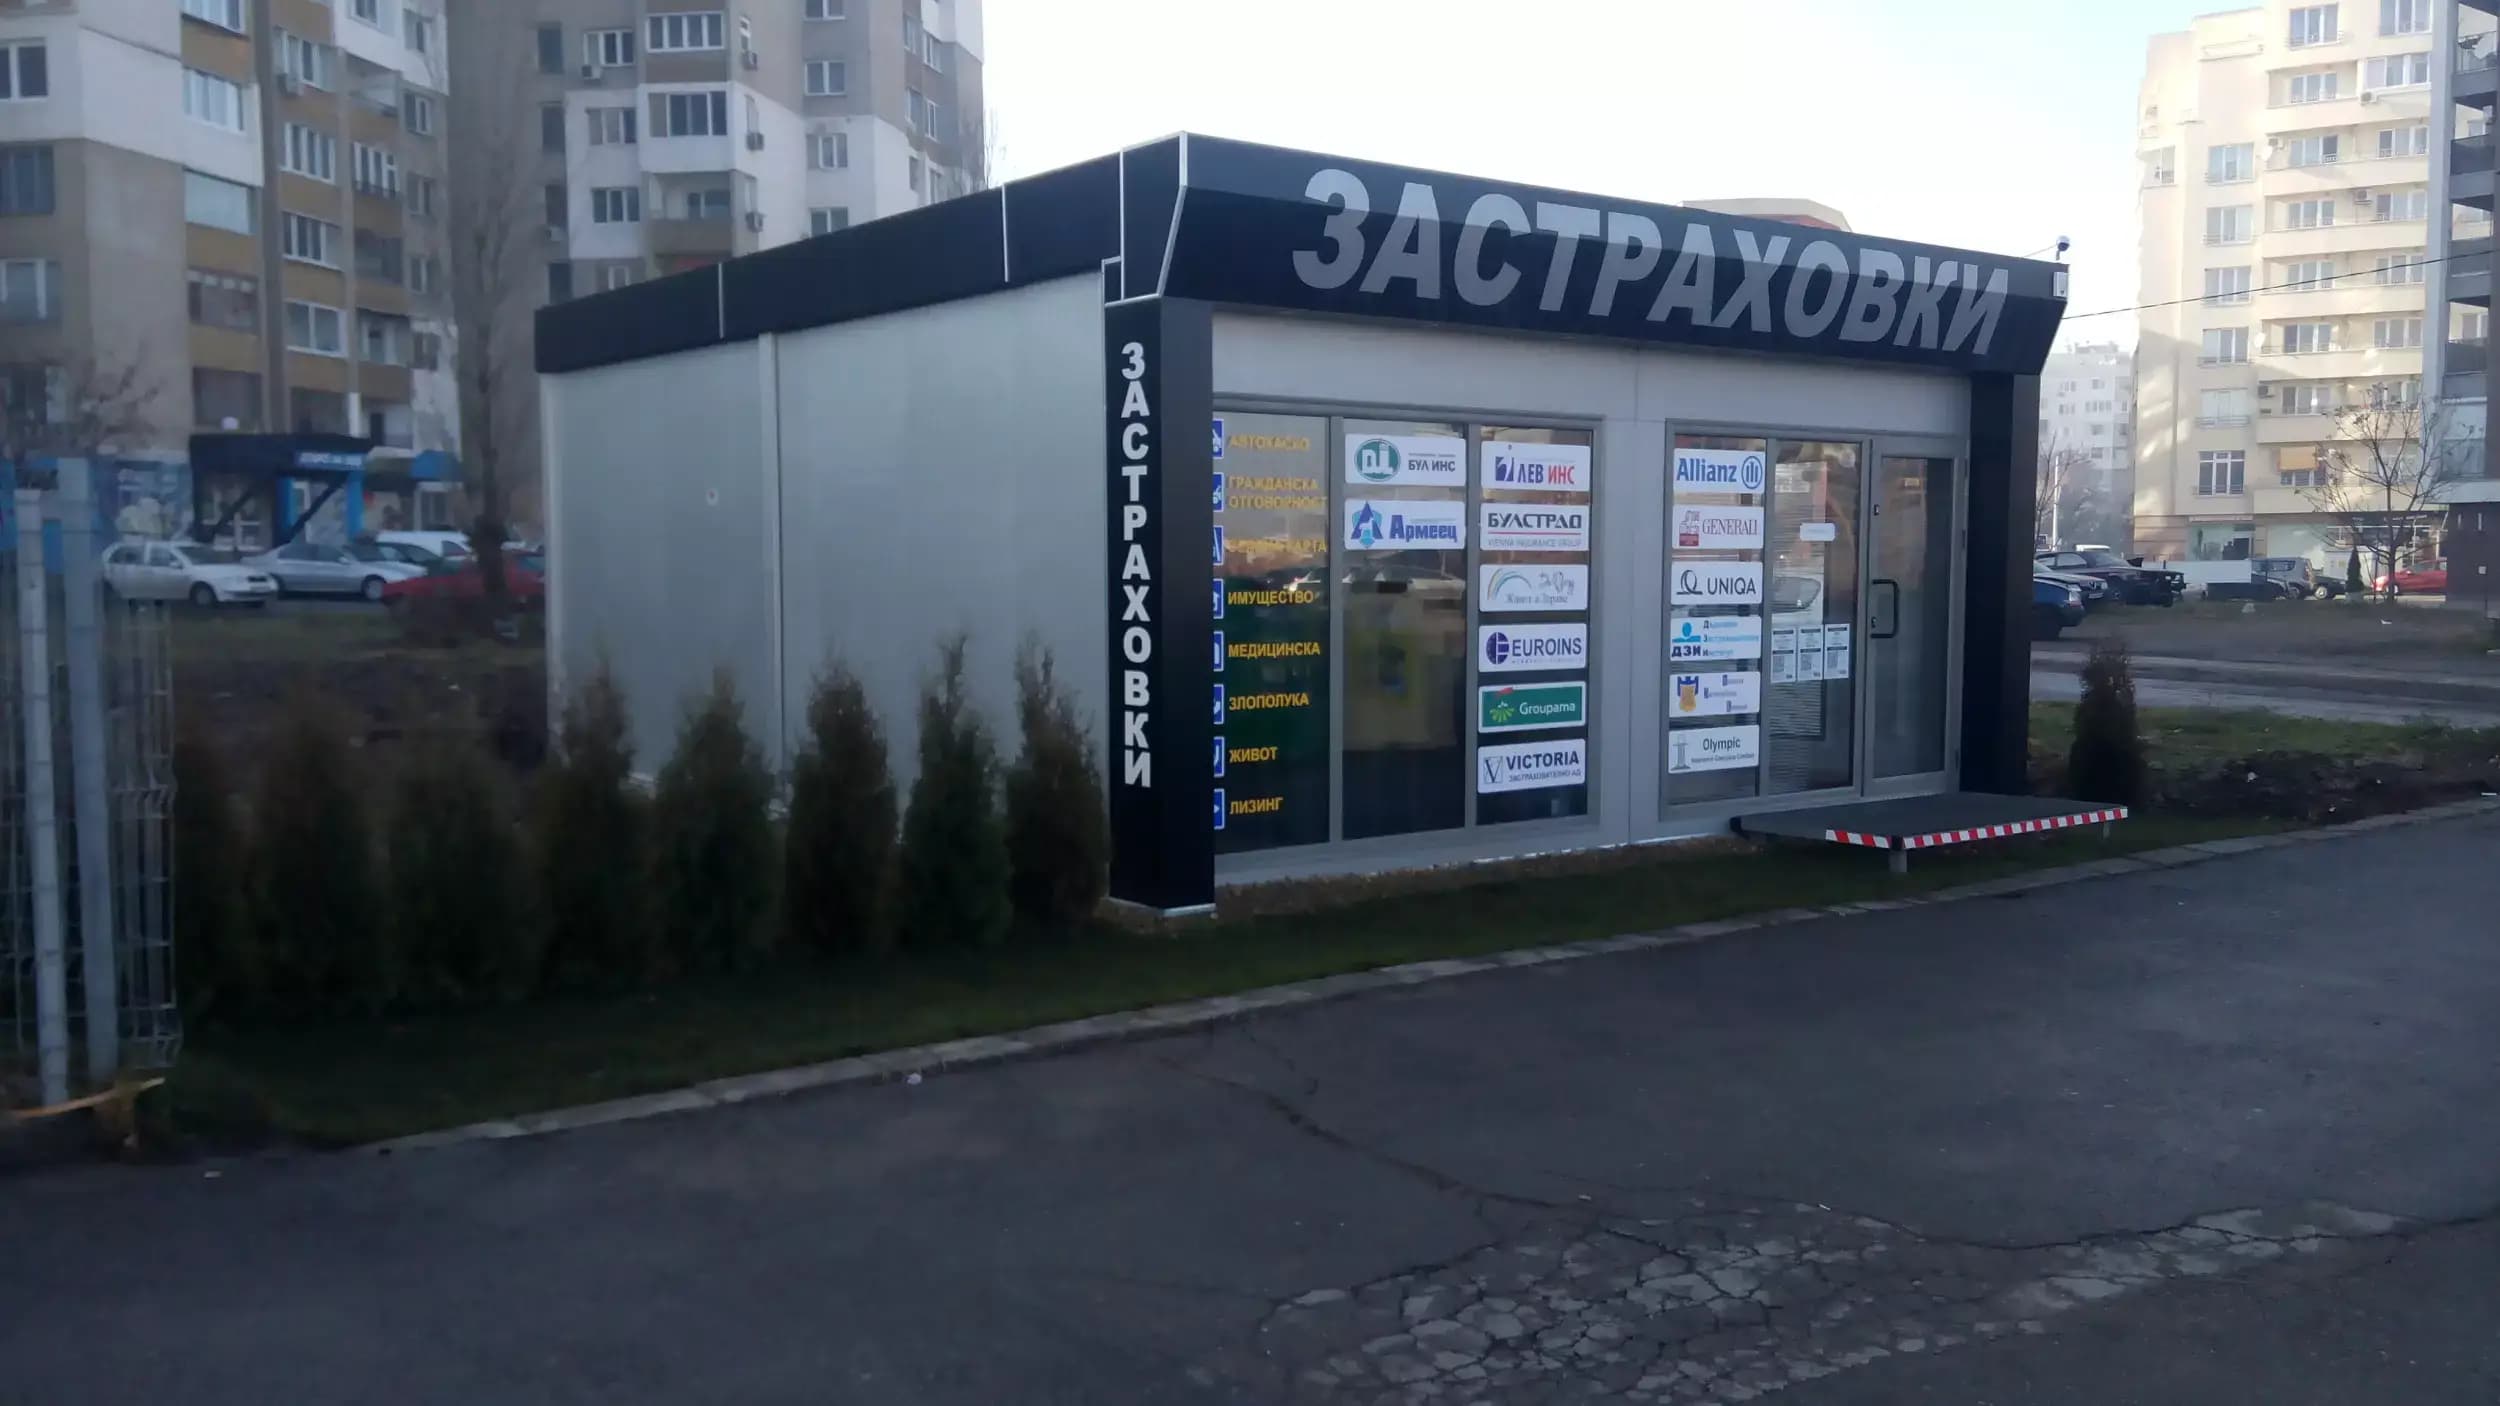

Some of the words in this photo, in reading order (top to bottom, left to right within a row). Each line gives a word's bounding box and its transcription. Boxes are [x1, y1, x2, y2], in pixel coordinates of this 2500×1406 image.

[1292, 168, 2009, 356] ЗАСТРАХОВКИ
[1408, 459, 1429, 472] БУЛ
[1431, 460, 1456, 472] ИНС
[1517, 463, 1544, 484] ЛЕВ
[1548, 465, 1575, 485] ИНС
[1676, 457, 1737, 483] Allianz
[1389, 514, 1458, 543] Армеец
[1487, 512, 1582, 529] БУЛСТРАД
[1702, 517, 1758, 537] GENERALI
[1285, 537, 1327, 553] АРТА
[1121, 342, 1151, 788] ЗАСТРАХОВКИ
[1707, 576, 1756, 595] UNIQA
[1228, 584, 1315, 607] ИМУЩЕСТВО
[1228, 642, 1321, 658] МЕДИЦИНСКА
[1512, 638, 1582, 657] EUROINS
[1671, 645, 1702, 658] ДЗИ
[1229, 693, 1309, 711] ЗЛОПОЛУКА
[1519, 701, 1577, 716] Groupama
[1702, 737, 1742, 753] Olympic
[1229, 746, 1278, 763] ЖИВОТ
[1506, 751, 1579, 771] VICTORIA
[1230, 797, 1284, 815] ЛИЗИНГ
